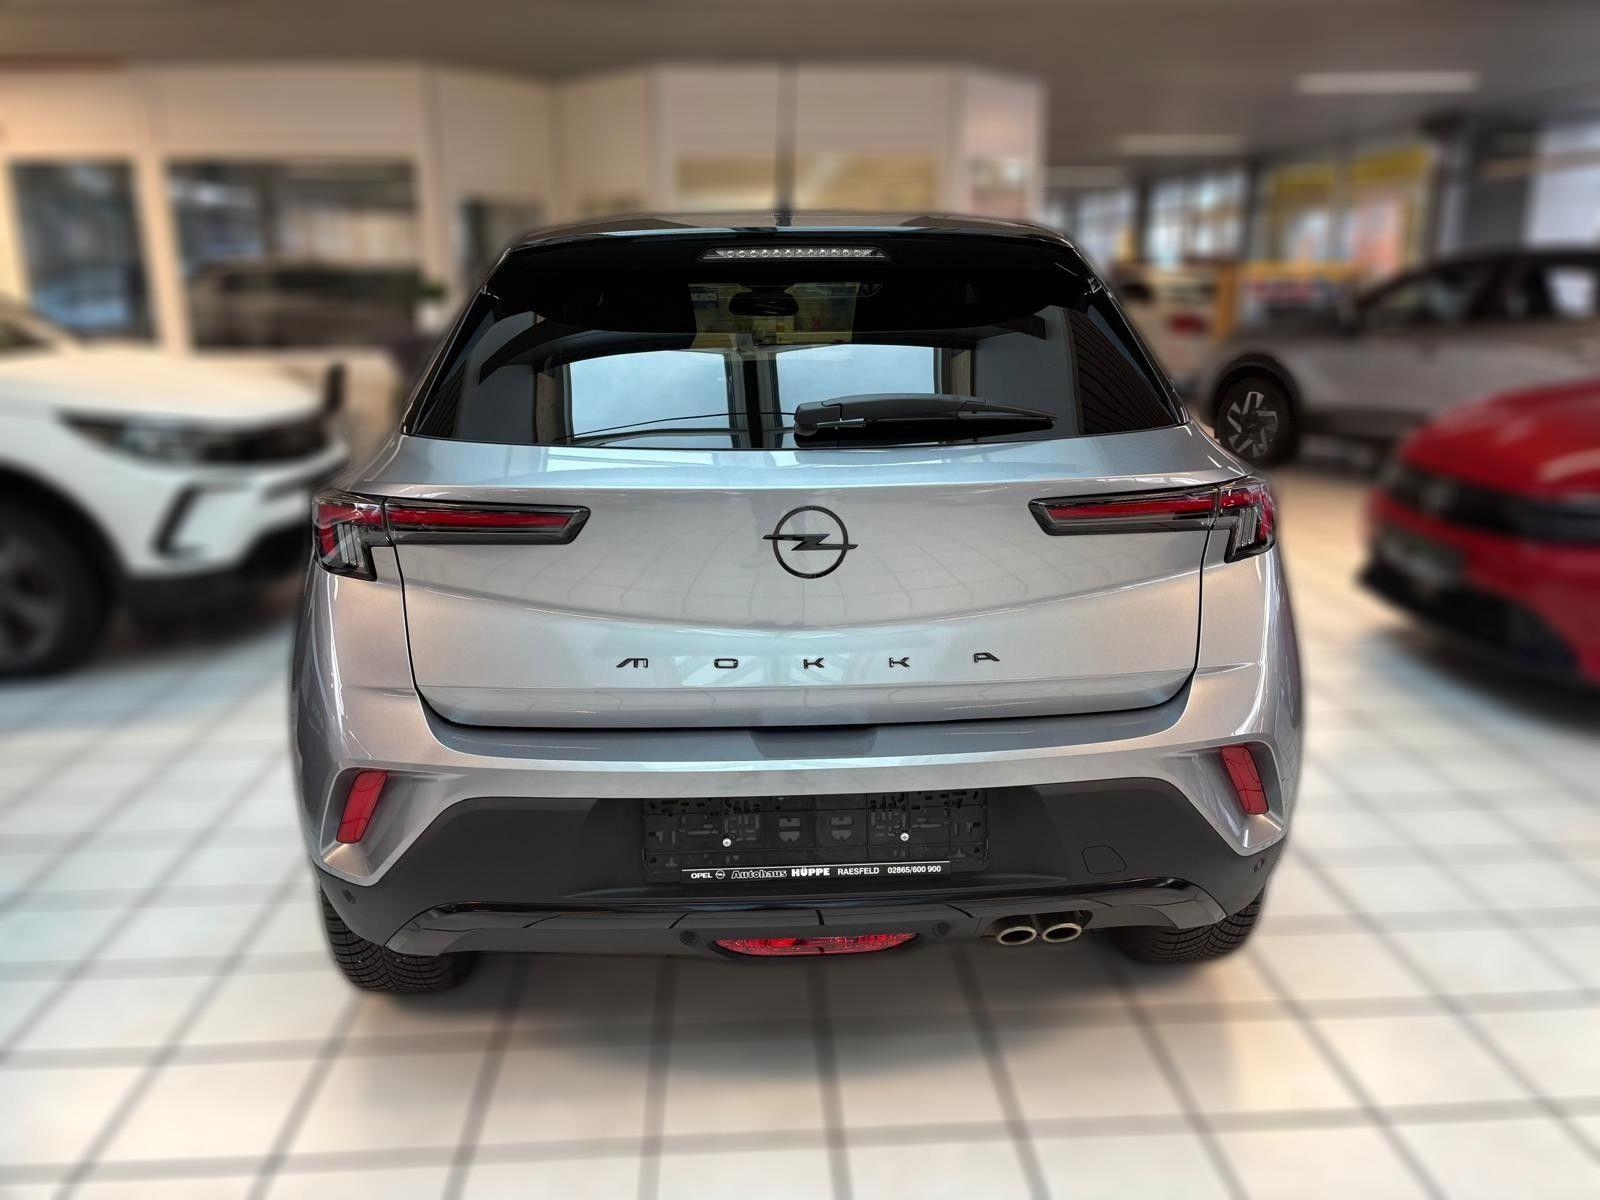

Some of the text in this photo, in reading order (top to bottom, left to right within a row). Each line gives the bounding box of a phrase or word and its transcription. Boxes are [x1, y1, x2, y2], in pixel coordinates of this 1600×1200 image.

[616, 652, 1001, 670] MOKKA
[731, 869, 788, 879] Autohaus
[791, 866, 831, 877] HÜPPE
[837, 867, 880, 876] RAESFELD
[887, 866, 926, 875] 02865/600
[927, 865, 942, 873] 900
